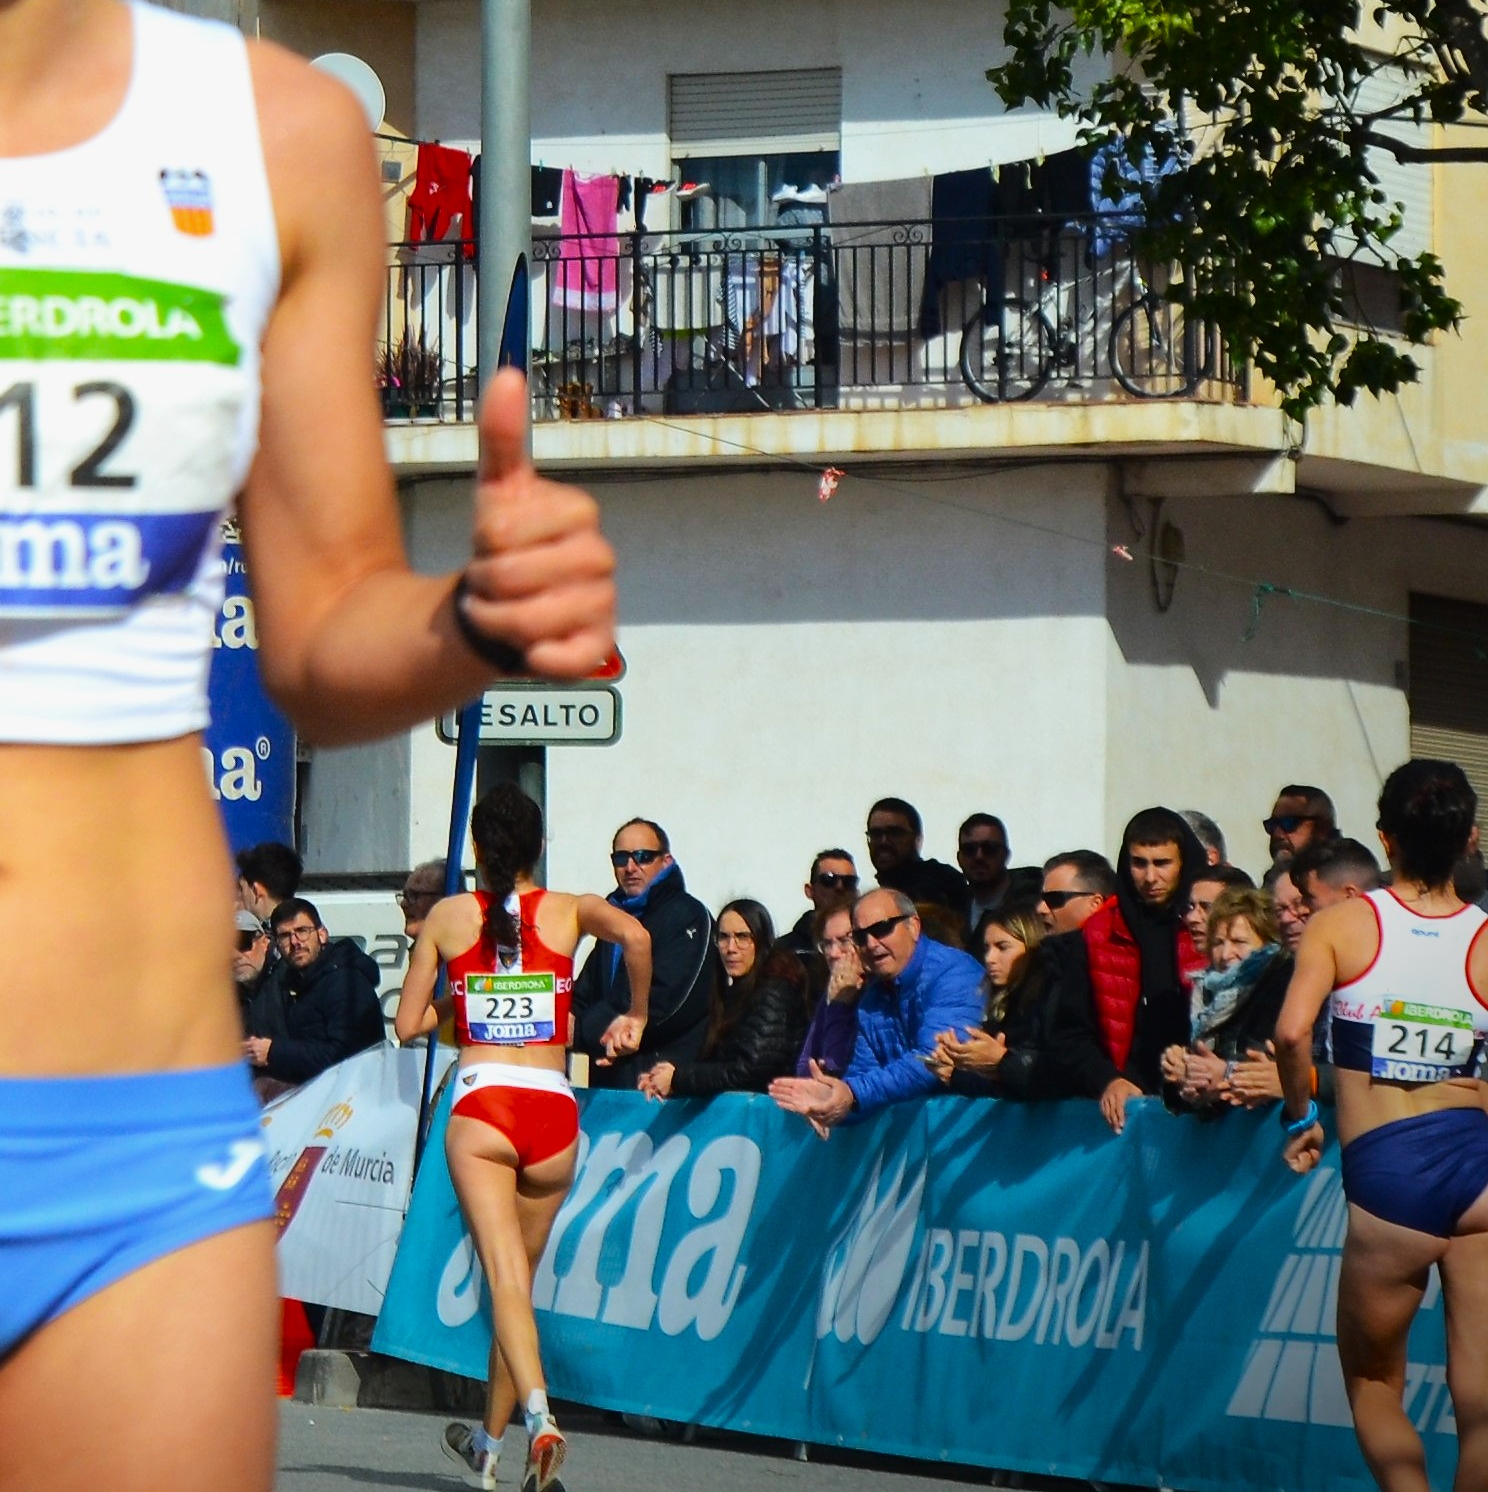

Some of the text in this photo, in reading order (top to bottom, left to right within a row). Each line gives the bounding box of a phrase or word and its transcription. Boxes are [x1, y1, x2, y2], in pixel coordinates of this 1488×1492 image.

[456, 703, 600, 728] ESALTO
[485, 996, 534, 1020] 223
[1387, 1024, 1456, 1060] 214
[339, 1148, 395, 1185] Murcia
[900, 1227, 1150, 1352] IBERDROLA
